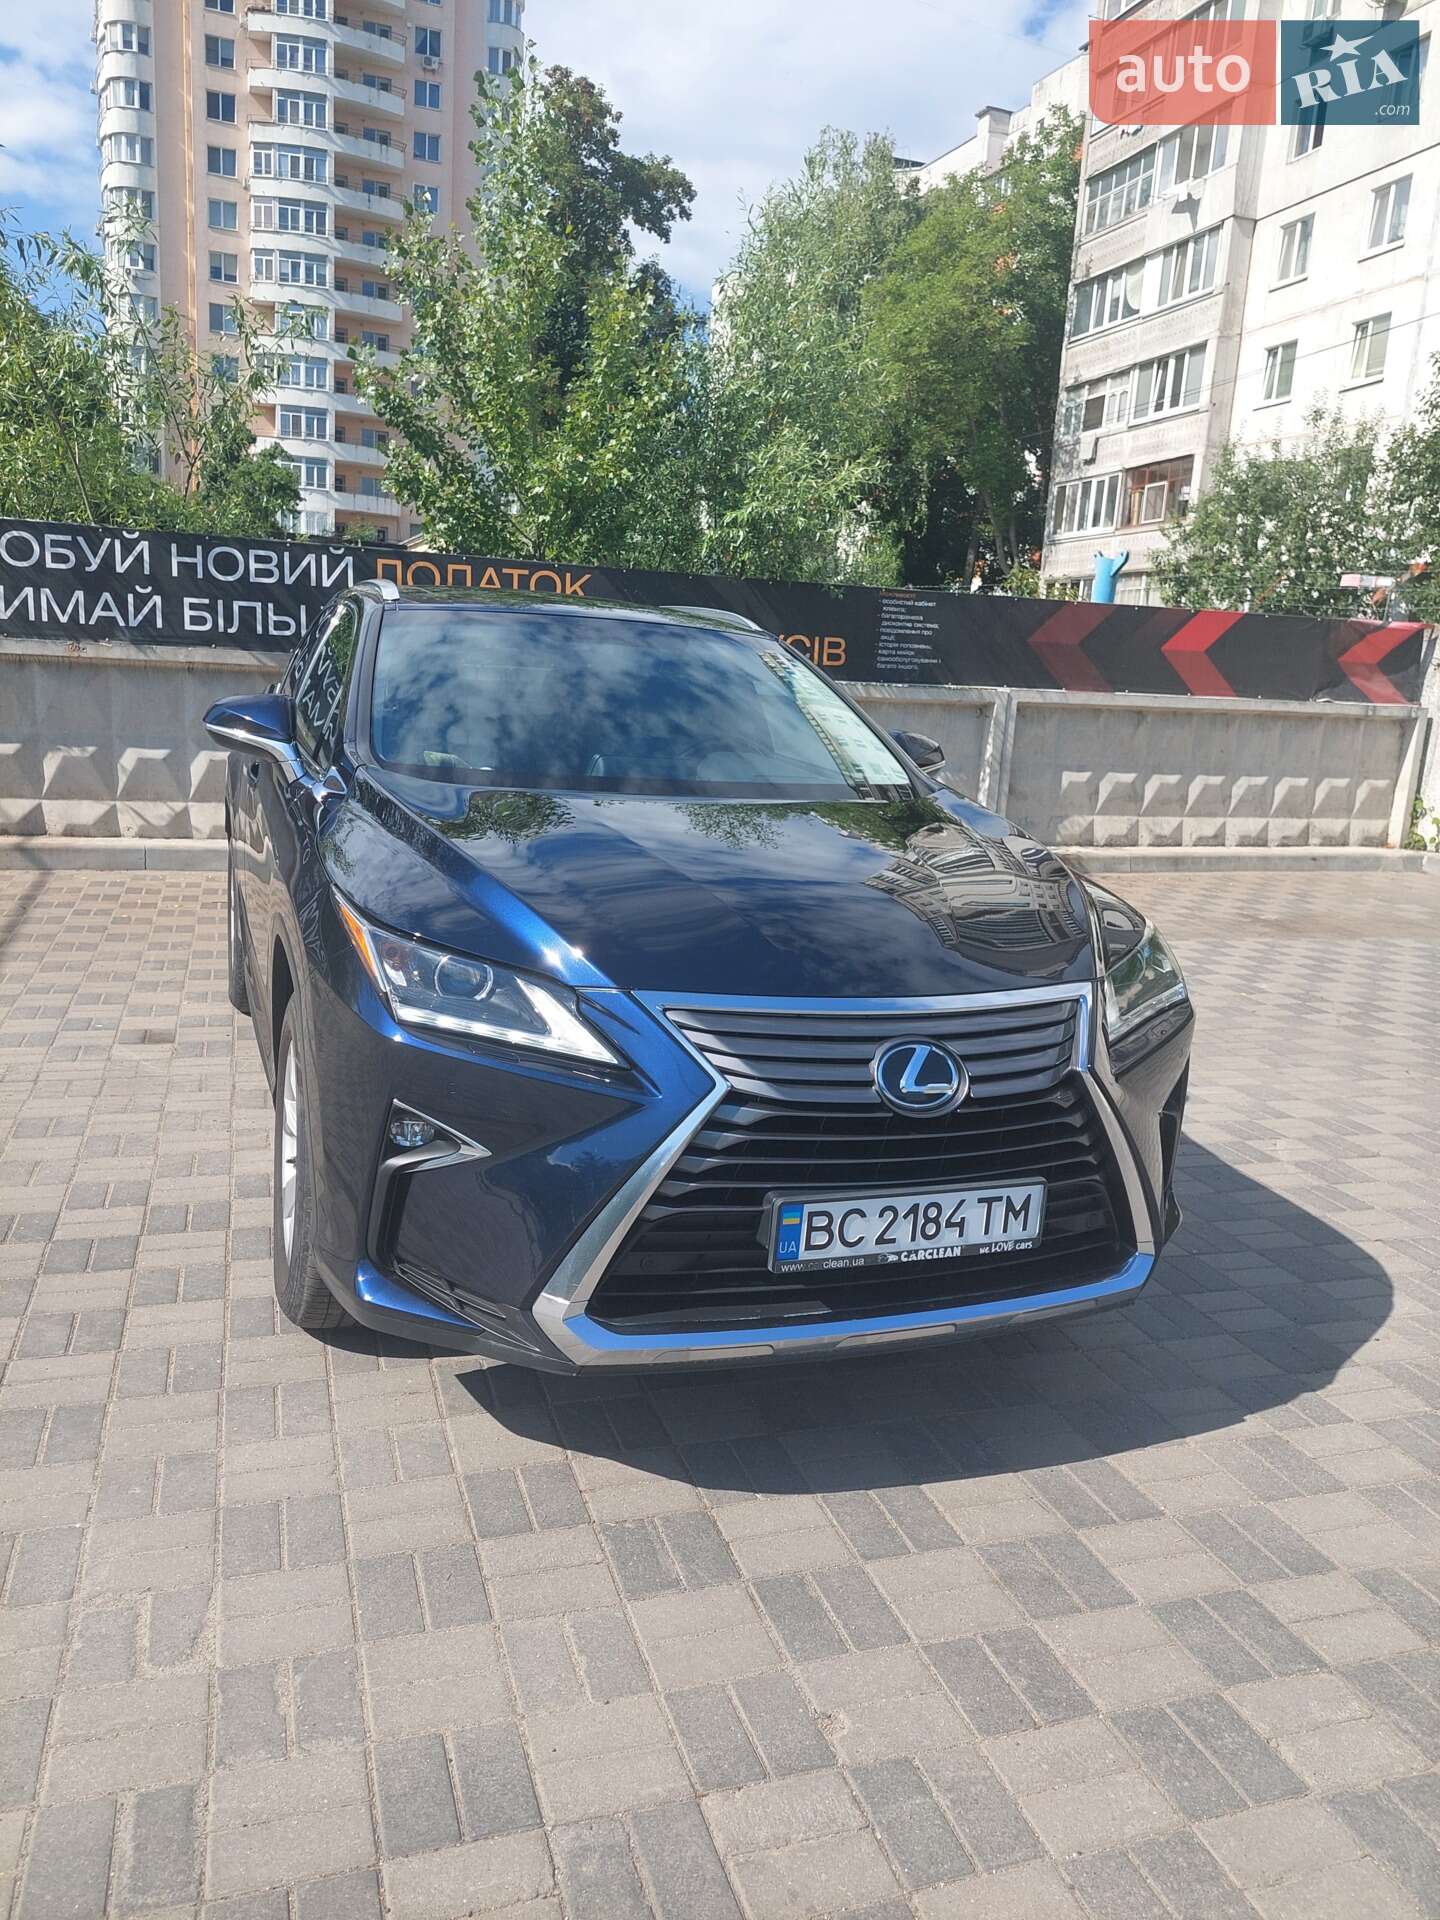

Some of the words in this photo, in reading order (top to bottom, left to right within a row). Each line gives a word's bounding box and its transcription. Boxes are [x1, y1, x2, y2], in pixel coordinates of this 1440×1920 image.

[0, 530, 150, 575] ОБУЙ
[171, 546, 354, 588] НОВИЙ
[0, 585, 163, 629] ИМАЙ
[183, 597, 307, 637] БІЛЬ
[779, 634, 847, 666] СІВ
[804, 1207, 868, 1251] BC
[874, 1199, 967, 1246] 2184
[977, 1193, 1032, 1236] TM
[779, 1240, 797, 1254] UA
[901, 1246, 962, 1262] CARCLEAN
[991, 1240, 1015, 1253] LOVE
